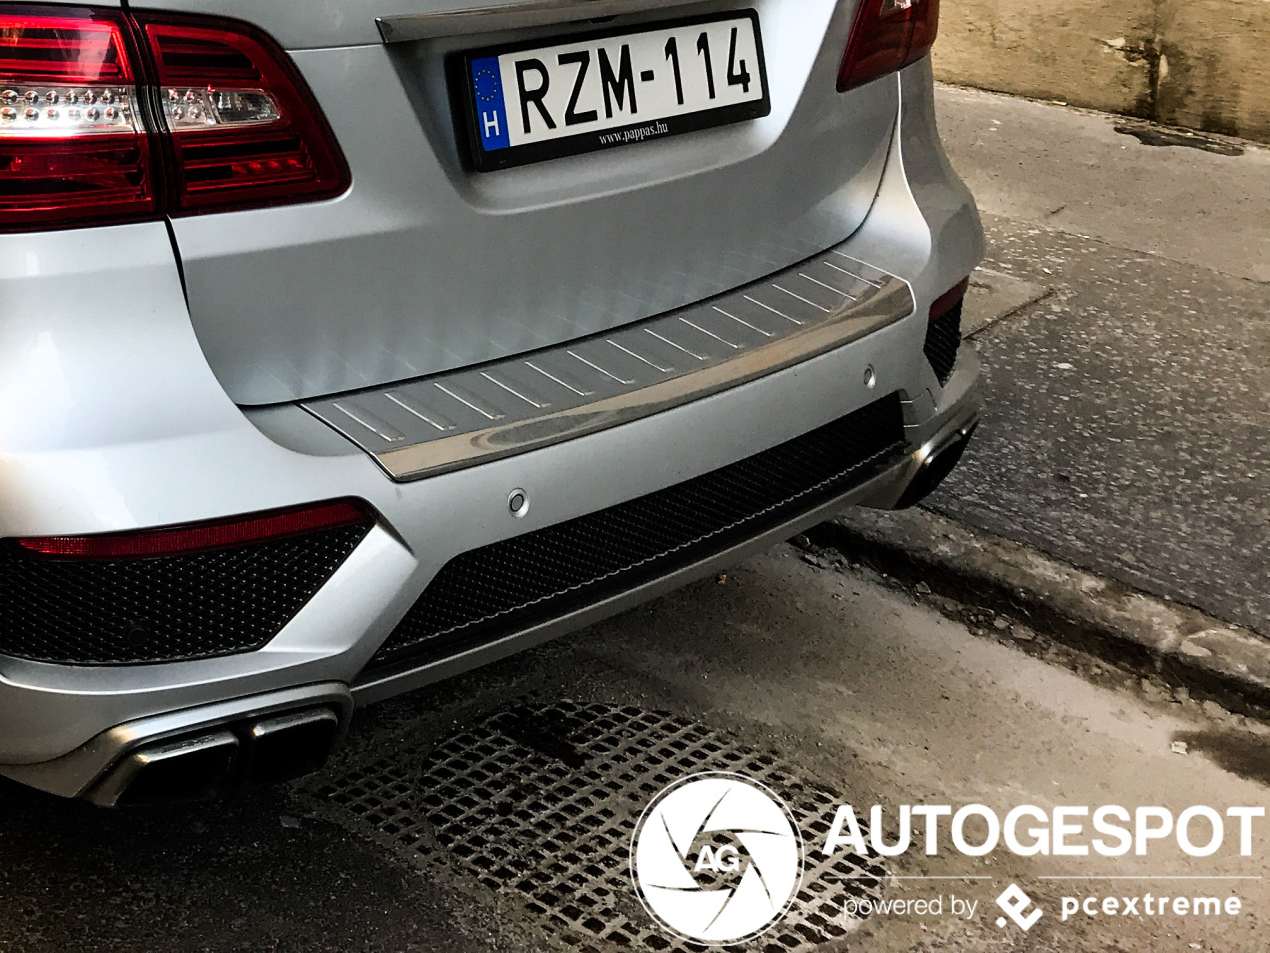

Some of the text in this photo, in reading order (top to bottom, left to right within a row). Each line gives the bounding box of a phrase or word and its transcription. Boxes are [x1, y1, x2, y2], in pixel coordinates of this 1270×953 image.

[482, 27, 751, 138] H RZM-114
[599, 121, 669, 145] www.pappas.hu
